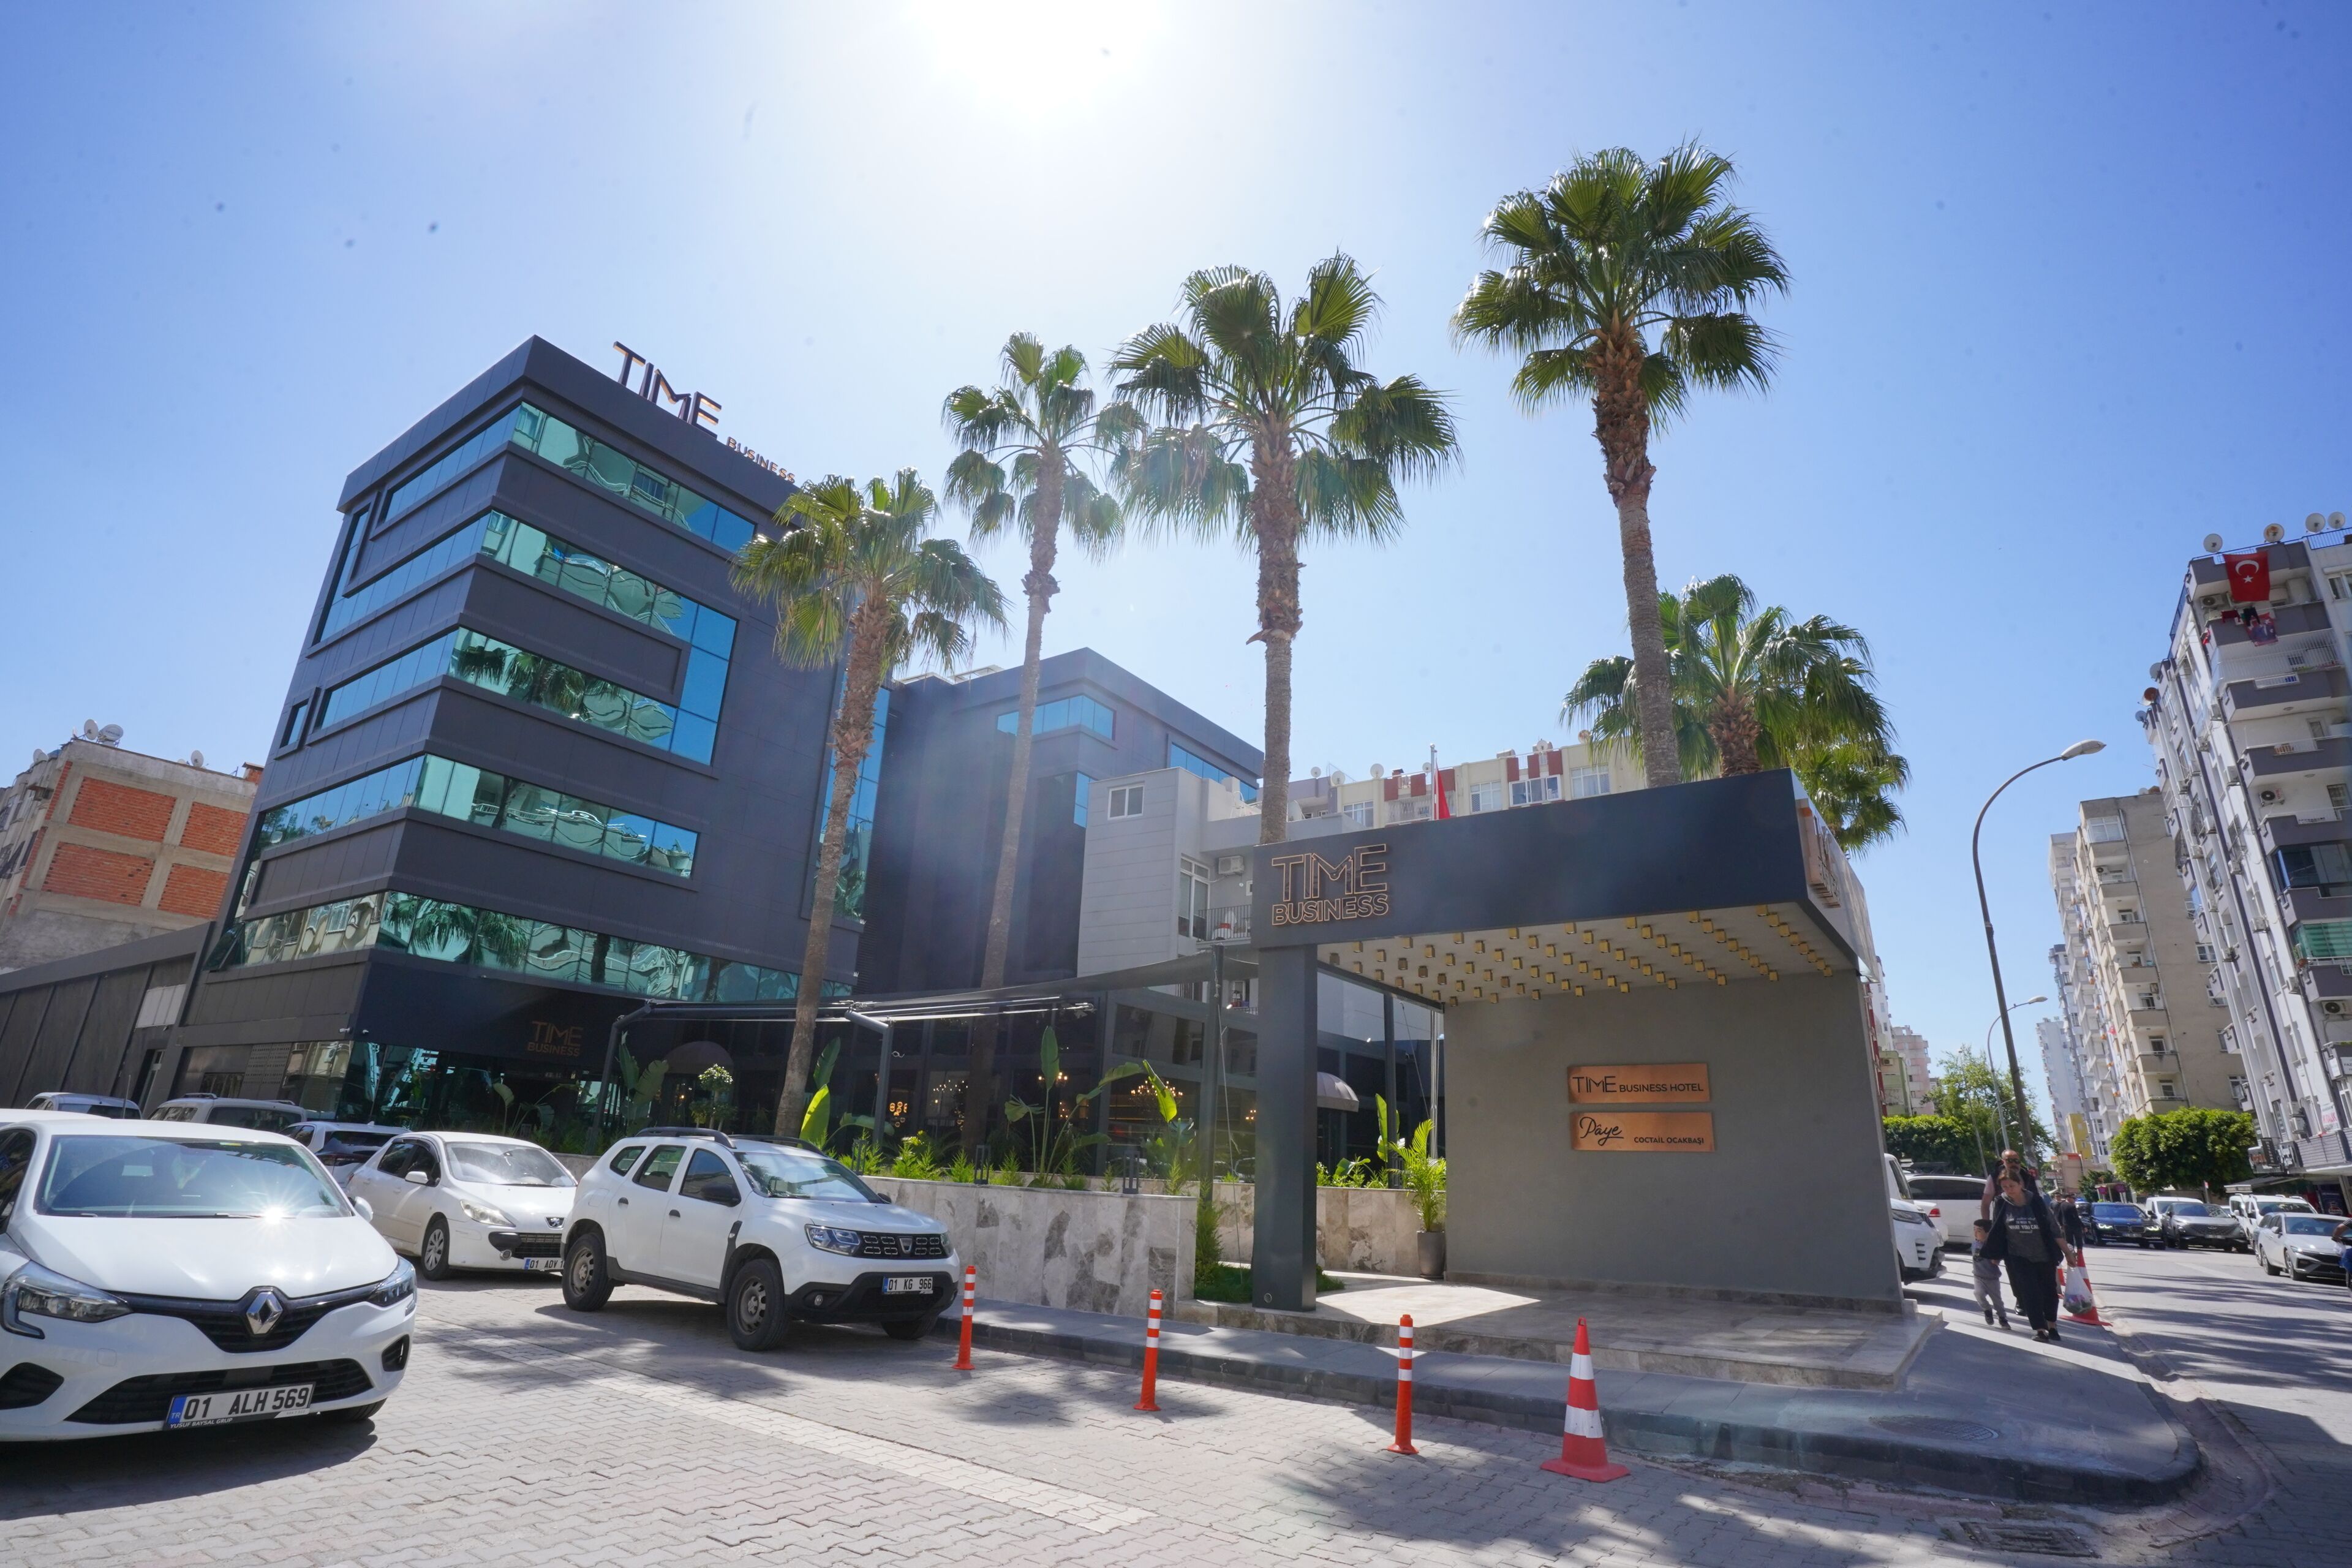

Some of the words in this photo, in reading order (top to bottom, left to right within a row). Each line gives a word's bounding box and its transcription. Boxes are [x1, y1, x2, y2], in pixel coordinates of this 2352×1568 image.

[612, 341, 722, 440] TIME
[726, 436, 796, 483] BUSINESS
[1272, 843, 1387, 902] TIME
[1272, 893, 1389, 925] BUSINESS
[527, 1041, 581, 1057] BUSINESS
[531, 1020, 584, 1047] TIME
[1572, 1076, 1616, 1093] TIME
[1619, 1084, 1668, 1093] BUSINESS
[1670, 1083, 1704, 1093] HOTEL
[1578, 1116, 1625, 1147] Pâye
[529, 1260, 539, 1268] 01
[544, 1260, 559, 1268] ADV
[888, 1279, 898, 1291] 01
[903, 1278, 913, 1290] KG
[919, 1278, 932, 1289] 966
[184, 1397, 212, 1420] 01
[228, 1391, 269, 1415] ALH
[272, 1387, 309, 1410] 569
